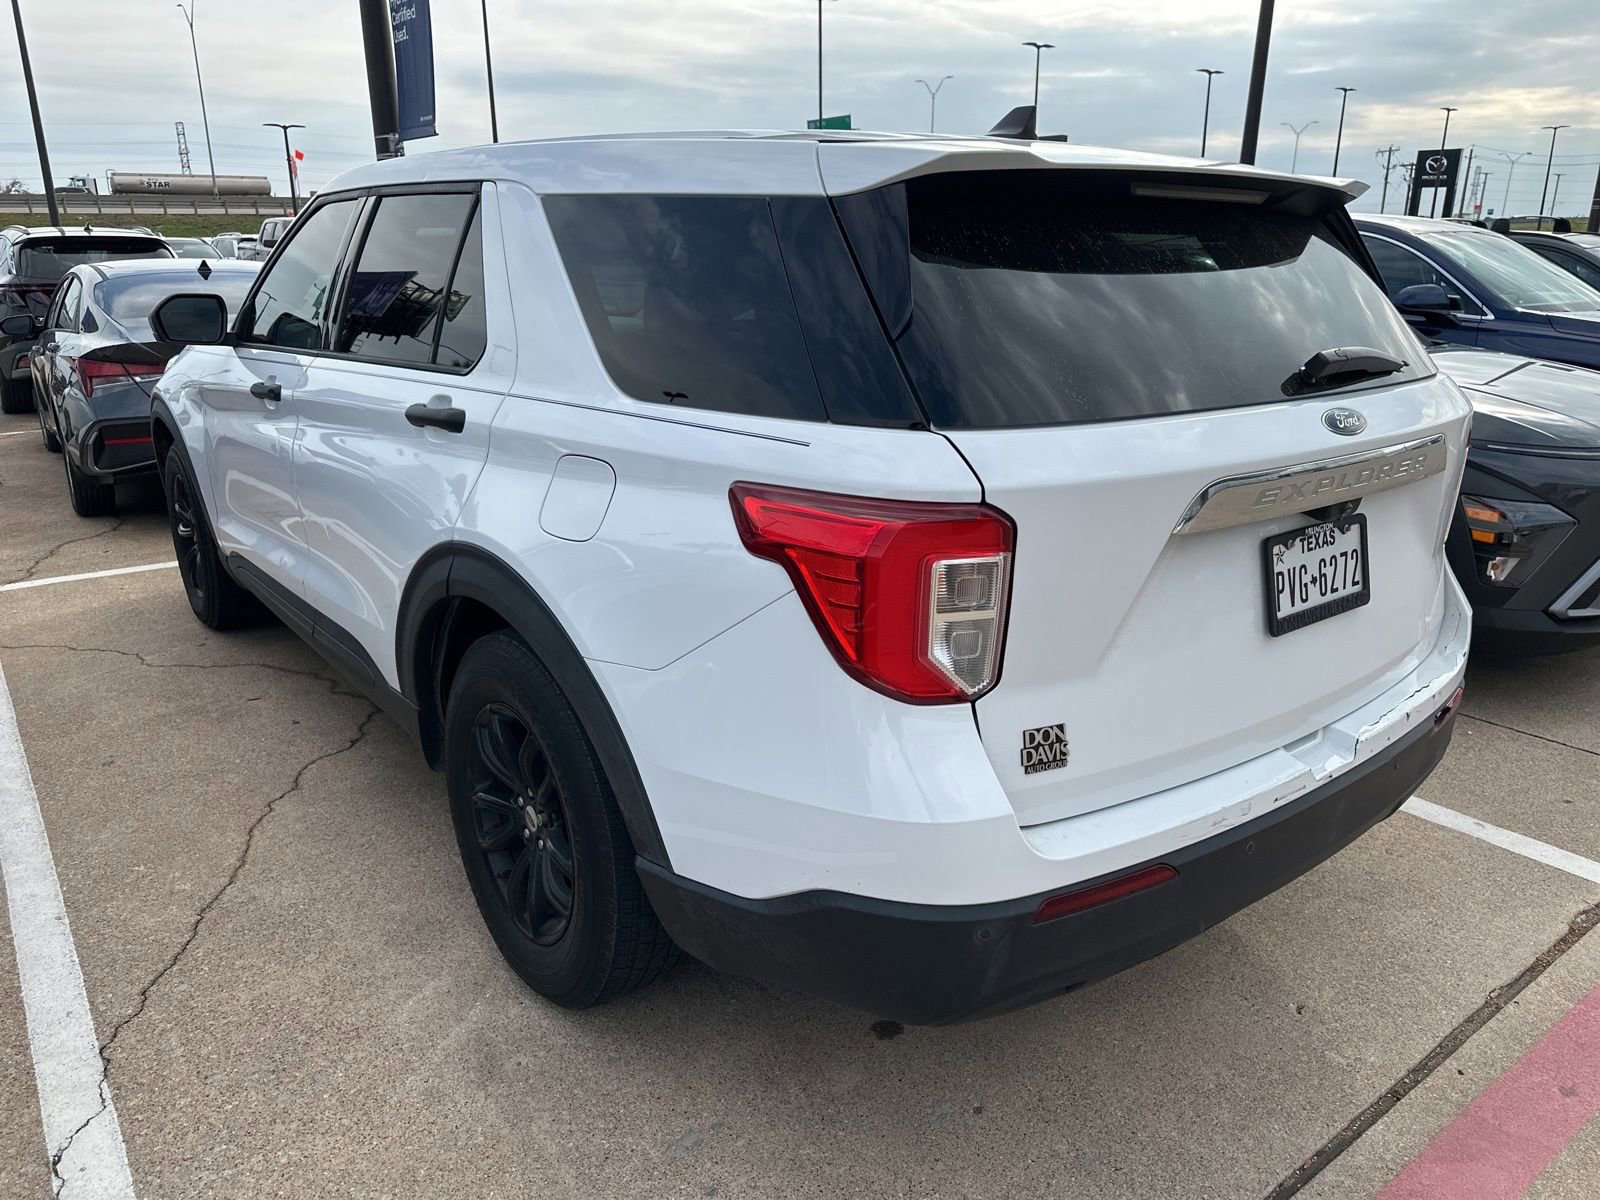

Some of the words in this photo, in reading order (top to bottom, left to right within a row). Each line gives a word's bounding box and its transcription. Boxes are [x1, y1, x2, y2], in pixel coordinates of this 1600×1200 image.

[146, 181, 170, 189] STAR
[1334, 411, 1360, 428] Ford
[1251, 453, 1427, 508] EXPLORER
[1299, 530, 1336, 554] TEXAS
[1024, 723, 1067, 748] DON
[1022, 741, 1070, 767] DAVIS
